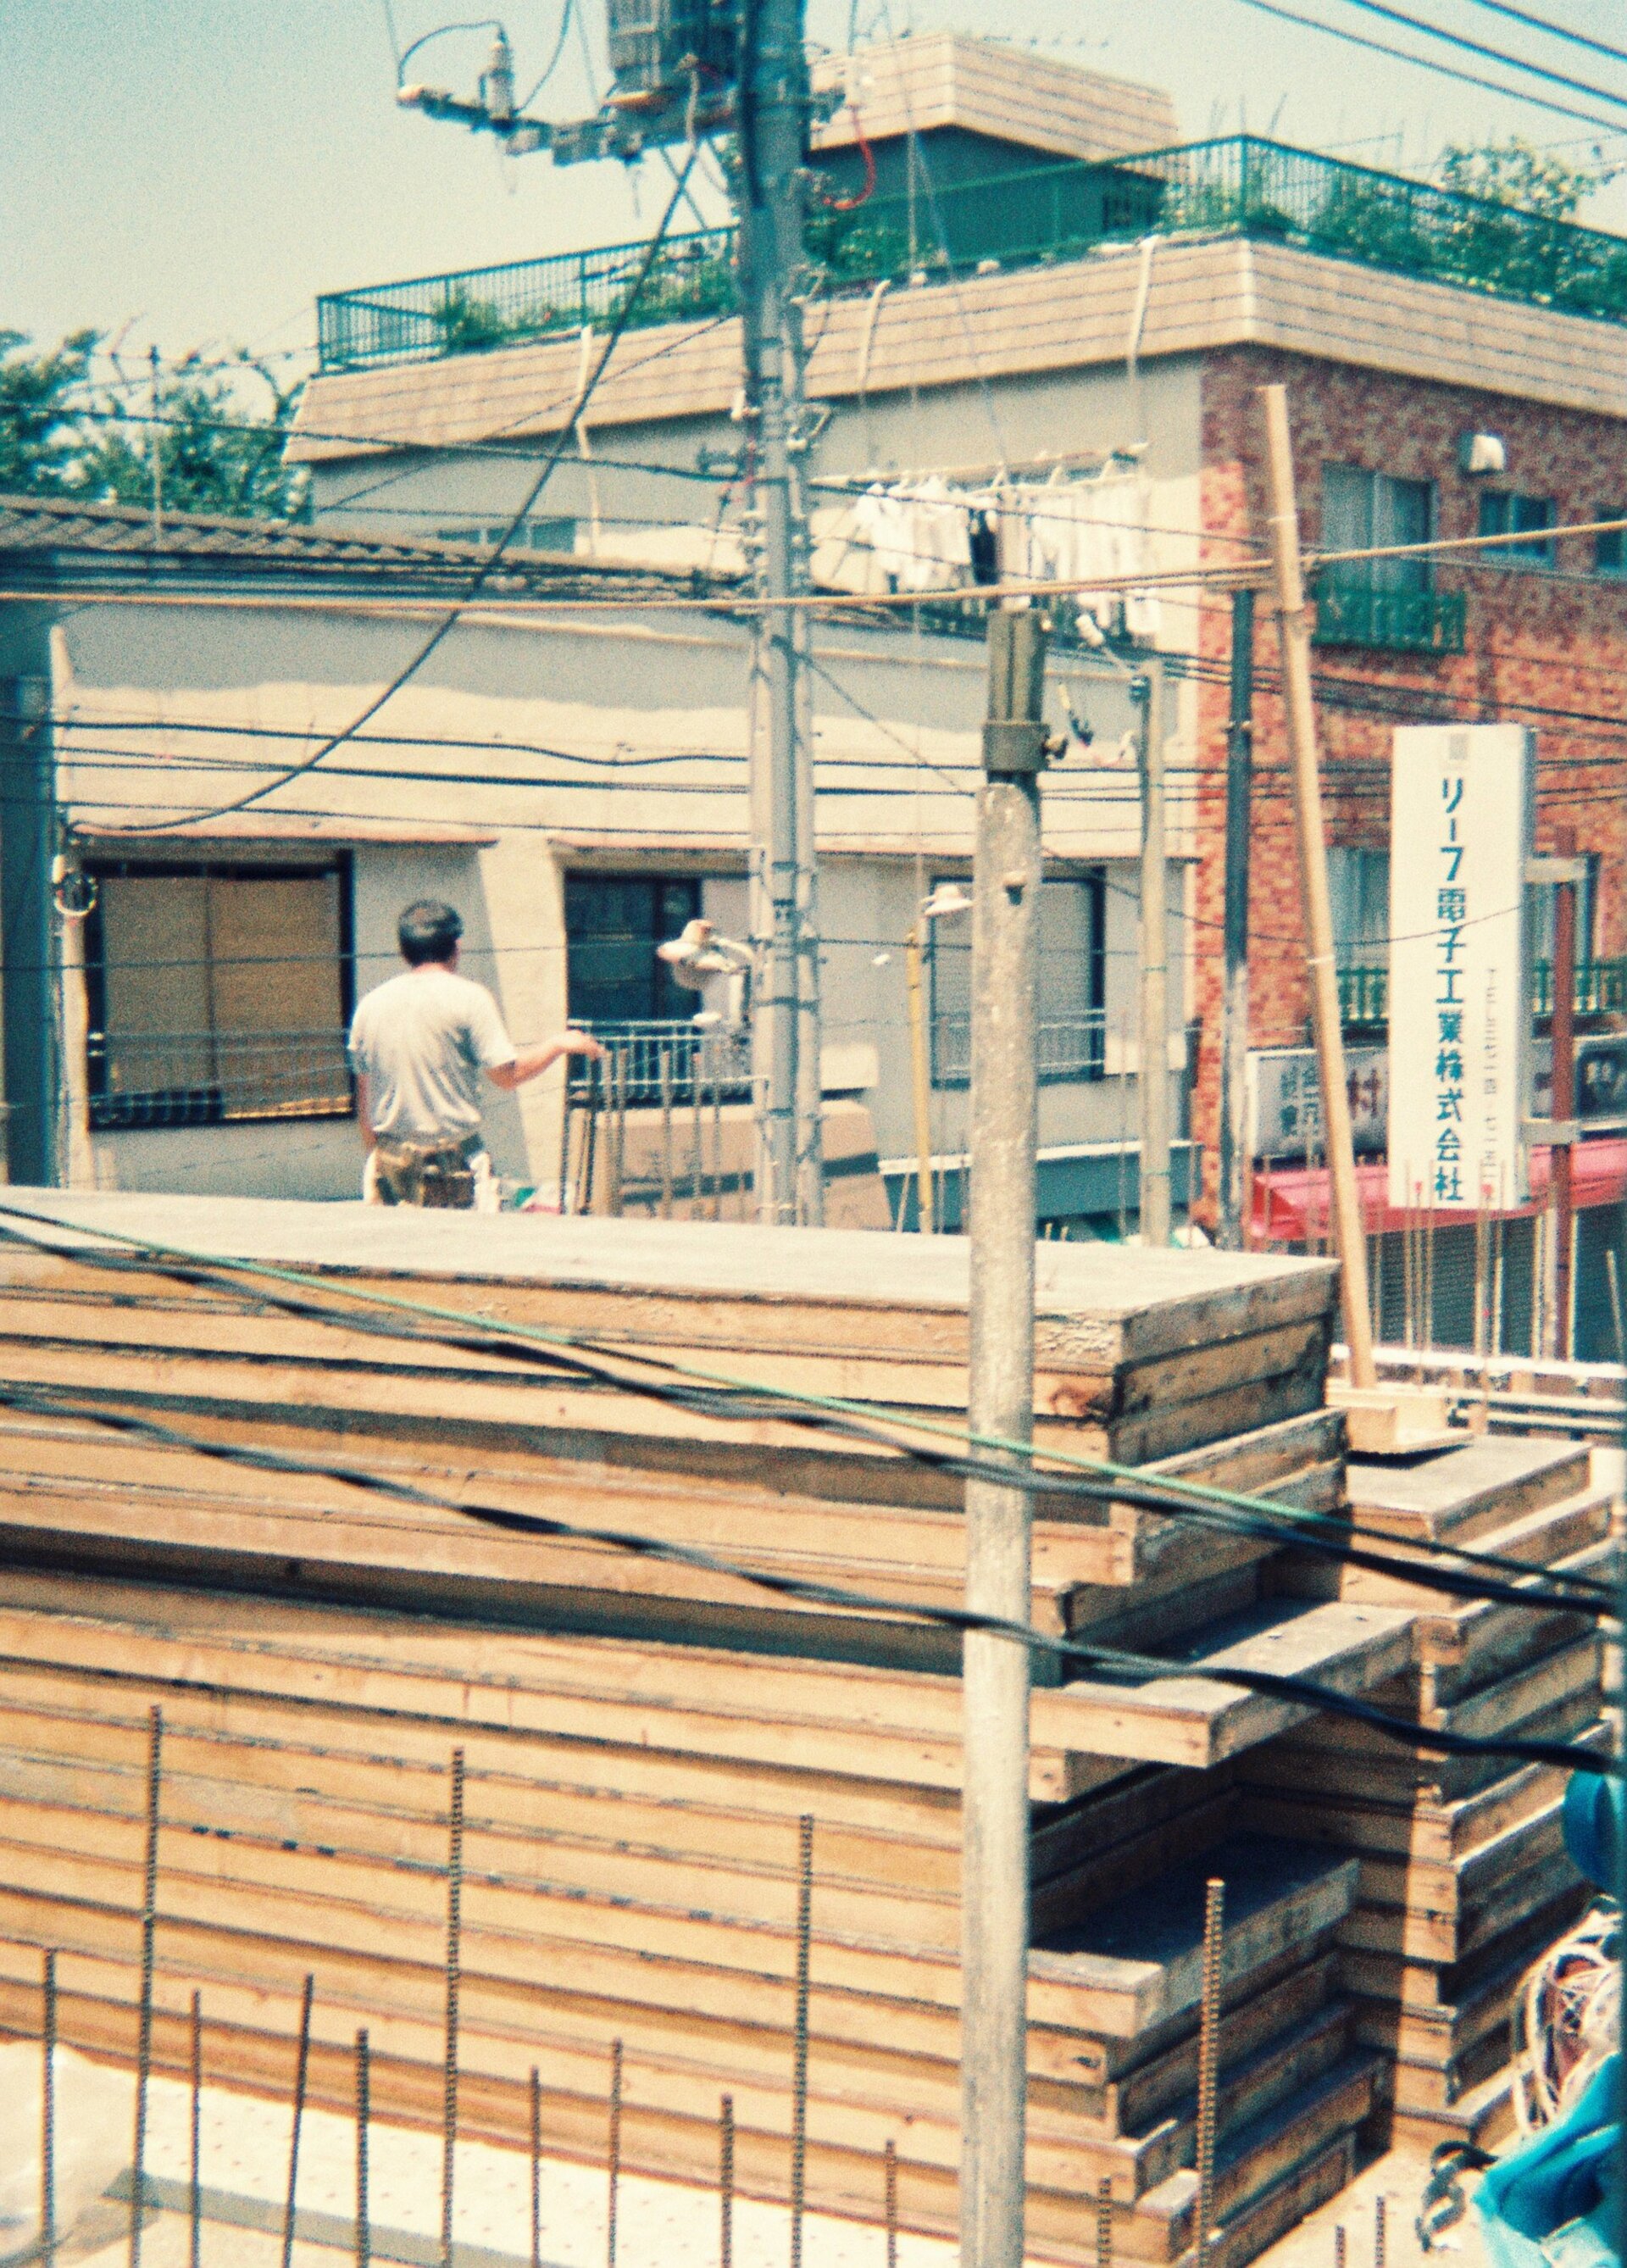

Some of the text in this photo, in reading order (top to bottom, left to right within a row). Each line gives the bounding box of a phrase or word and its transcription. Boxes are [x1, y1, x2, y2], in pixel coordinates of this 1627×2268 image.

[1435, 777, 1467, 1202] リーフ電子工業株式会社
